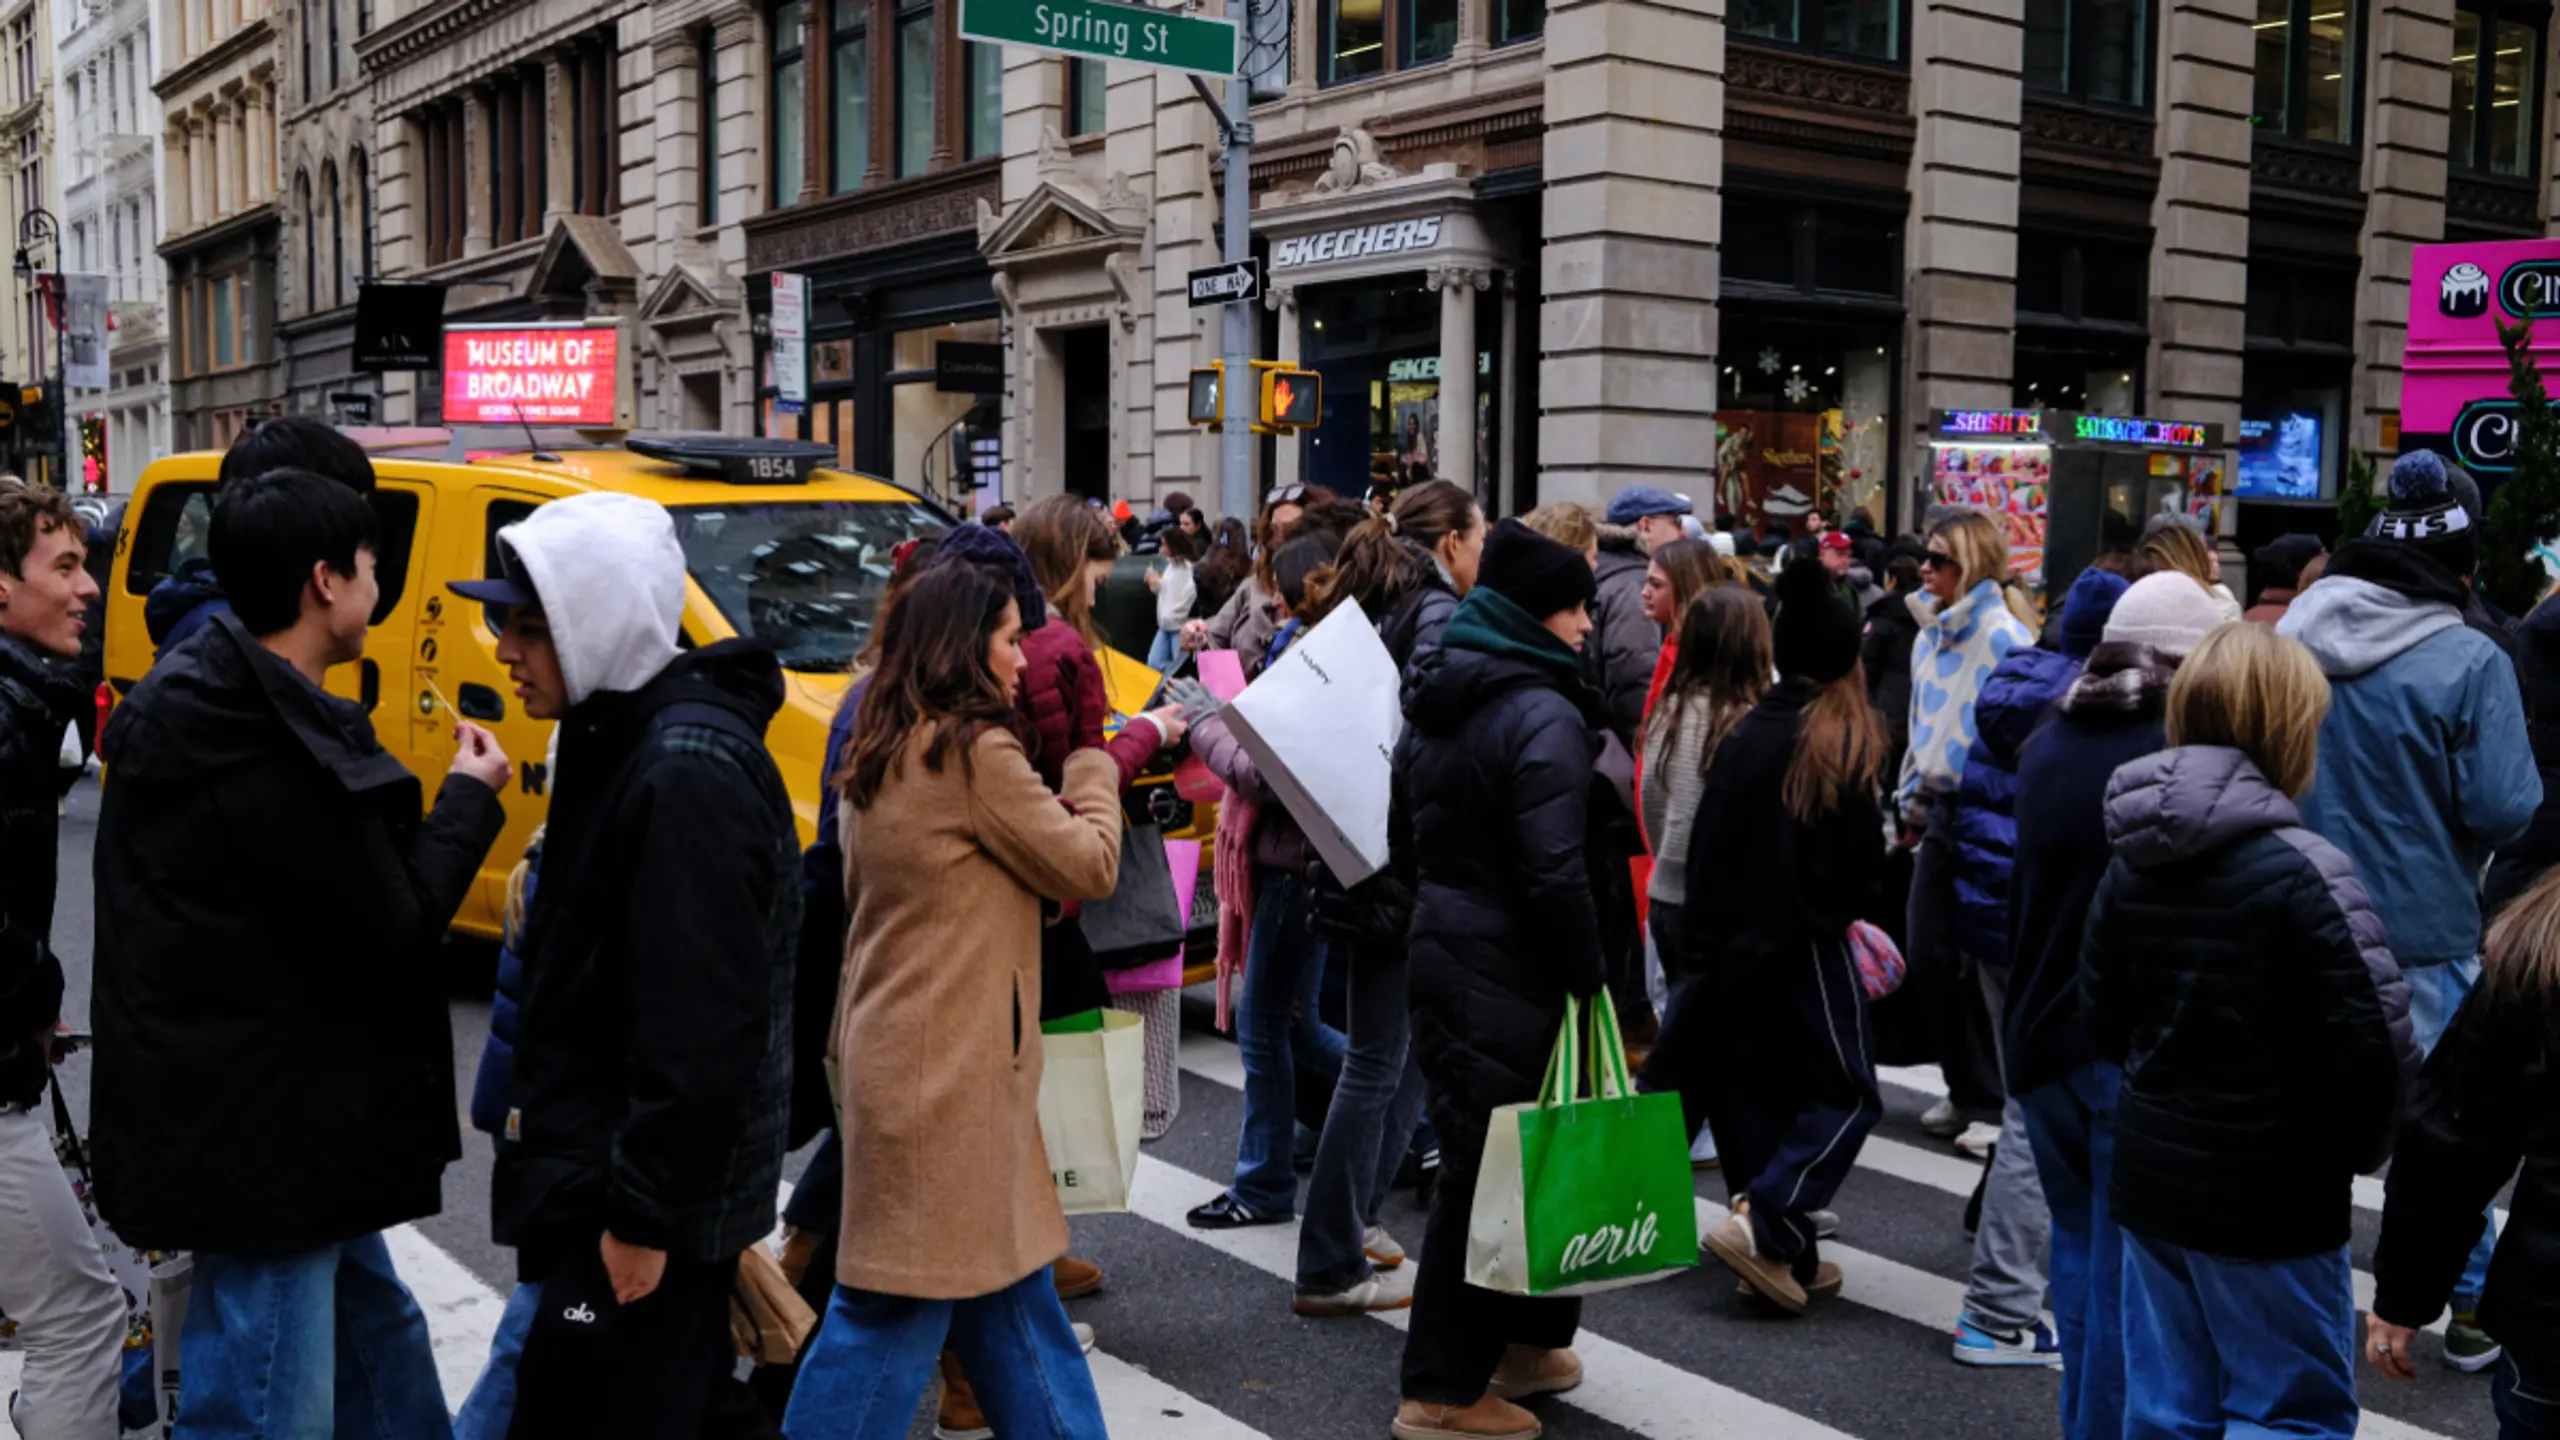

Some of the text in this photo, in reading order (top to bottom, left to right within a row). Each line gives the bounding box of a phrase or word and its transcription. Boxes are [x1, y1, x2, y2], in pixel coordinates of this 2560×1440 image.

[1034, 4, 1169, 55] Spring St
[1276, 215, 1443, 268] SKECHERS
[1196, 272, 1248, 296] ONE WAY
[466, 339, 594, 366] MUSEUM OF
[467, 372, 595, 399] BROADWAY
[1560, 1201, 1659, 1273] aerie
[563, 1302, 596, 1323] alo
